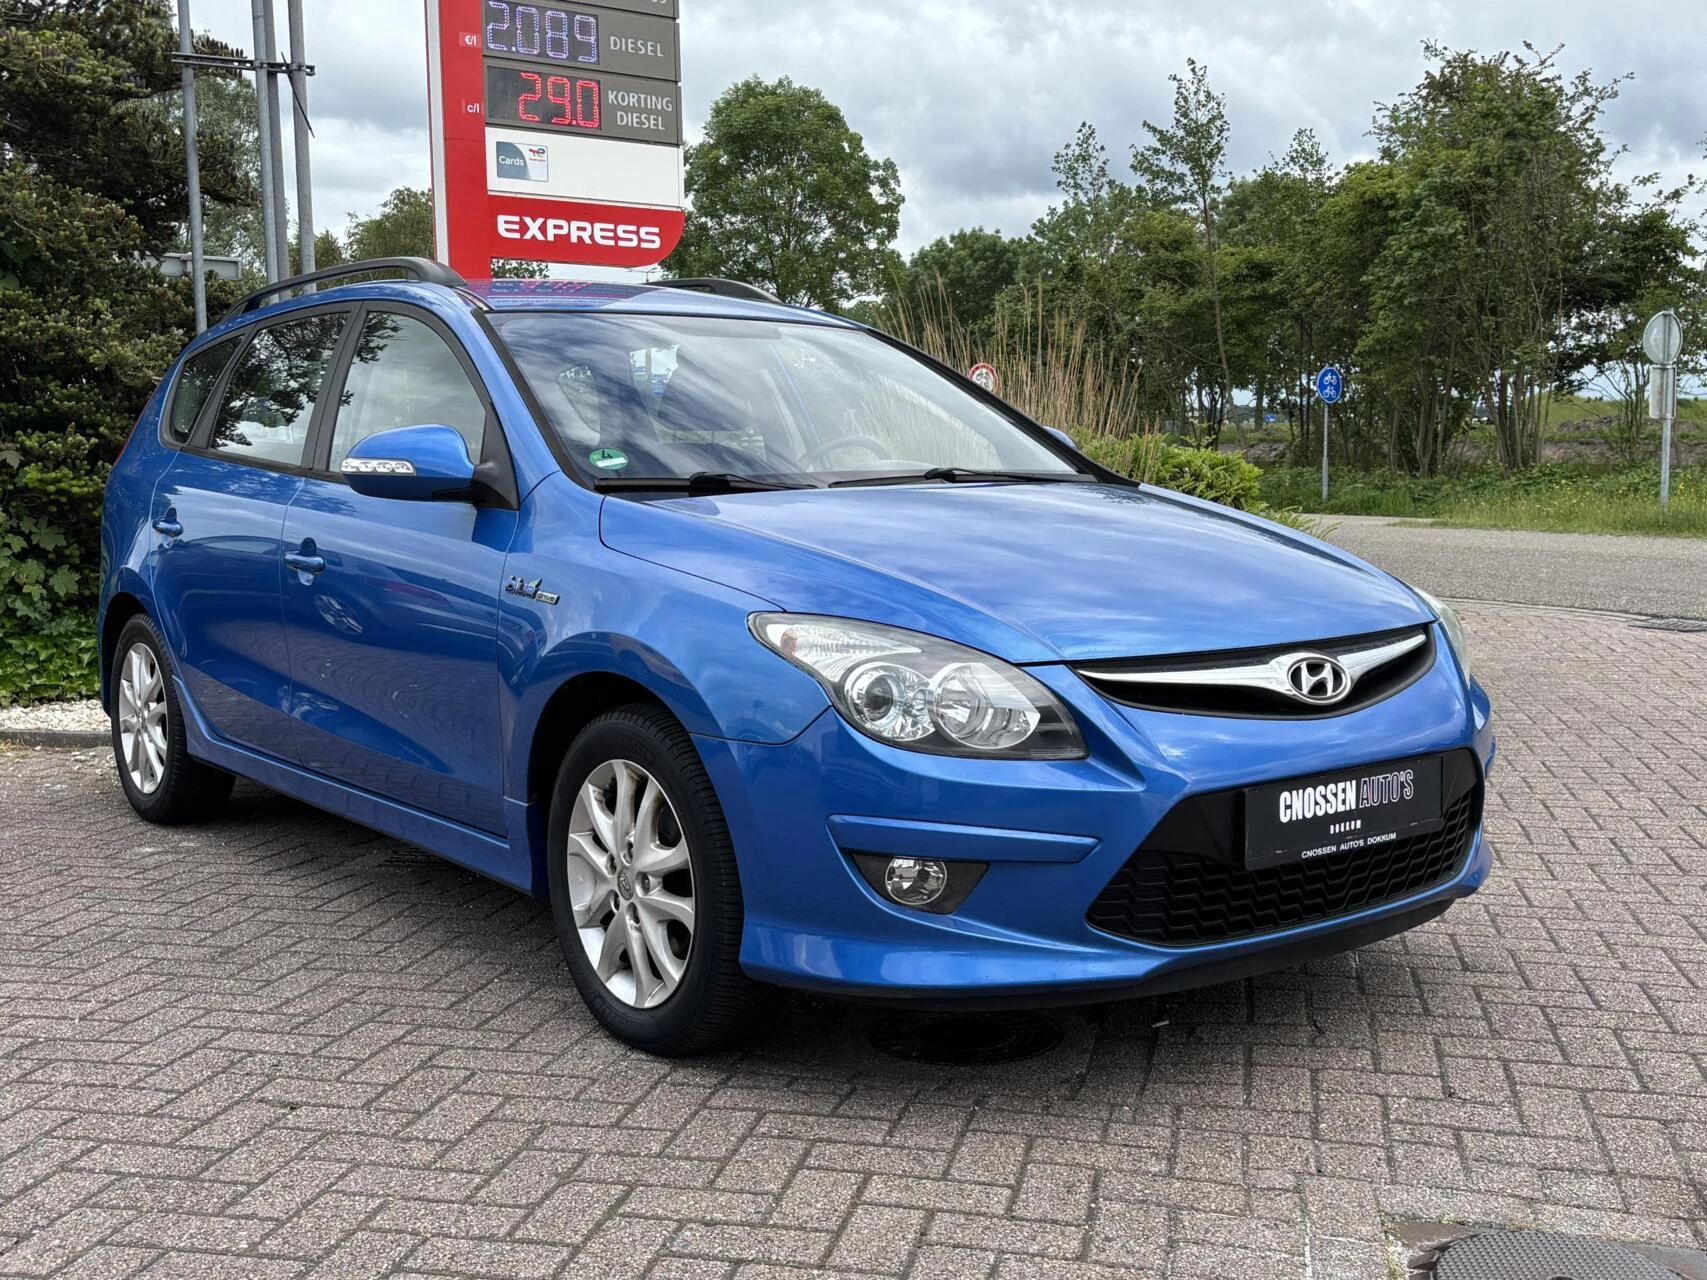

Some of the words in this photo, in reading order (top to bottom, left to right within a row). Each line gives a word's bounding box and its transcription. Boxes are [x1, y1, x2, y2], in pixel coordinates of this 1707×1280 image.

[486, 1, 598, 63] 2.089
[609, 36, 665, 57] DIESEL
[518, 72, 601, 128] 29.0
[608, 90, 673, 112] KORTING
[616, 110, 665, 130] DIESEL
[498, 155, 525, 166] Cards
[496, 214, 661, 249] EXPRESS
[1279, 779, 1357, 823] CNOSSEN
[1359, 769, 1414, 809] AUTO'S
[1301, 845, 1337, 859] CNOSSEN
[1340, 838, 1364, 851] AUTO'S
[1367, 832, 1397, 845] DOKKUM
